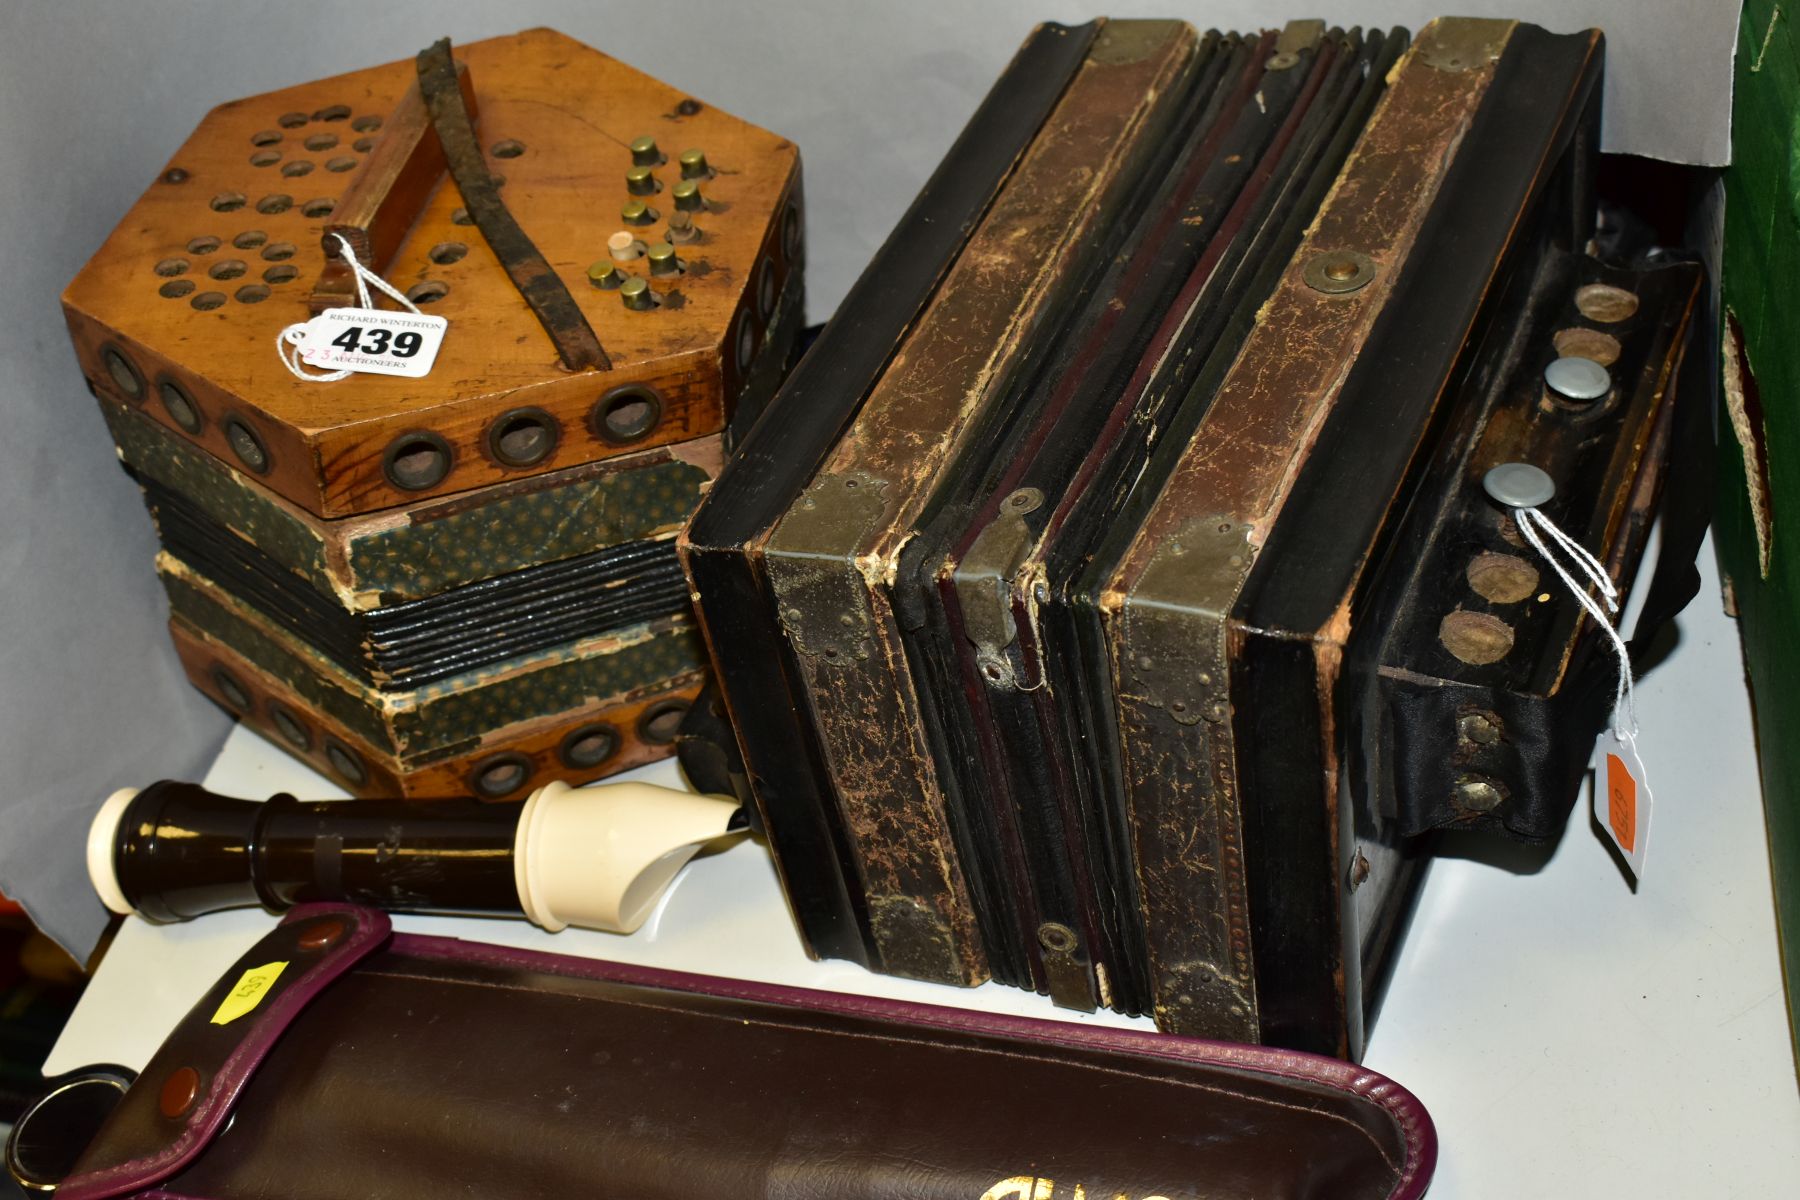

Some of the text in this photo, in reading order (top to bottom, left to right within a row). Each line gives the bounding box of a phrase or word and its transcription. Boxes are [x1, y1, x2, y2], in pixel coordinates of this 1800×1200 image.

[329, 314, 442, 329] RICHARD WINTERTON
[331, 327, 423, 358] 439
[332, 356, 407, 368] AUCTIONEERS
